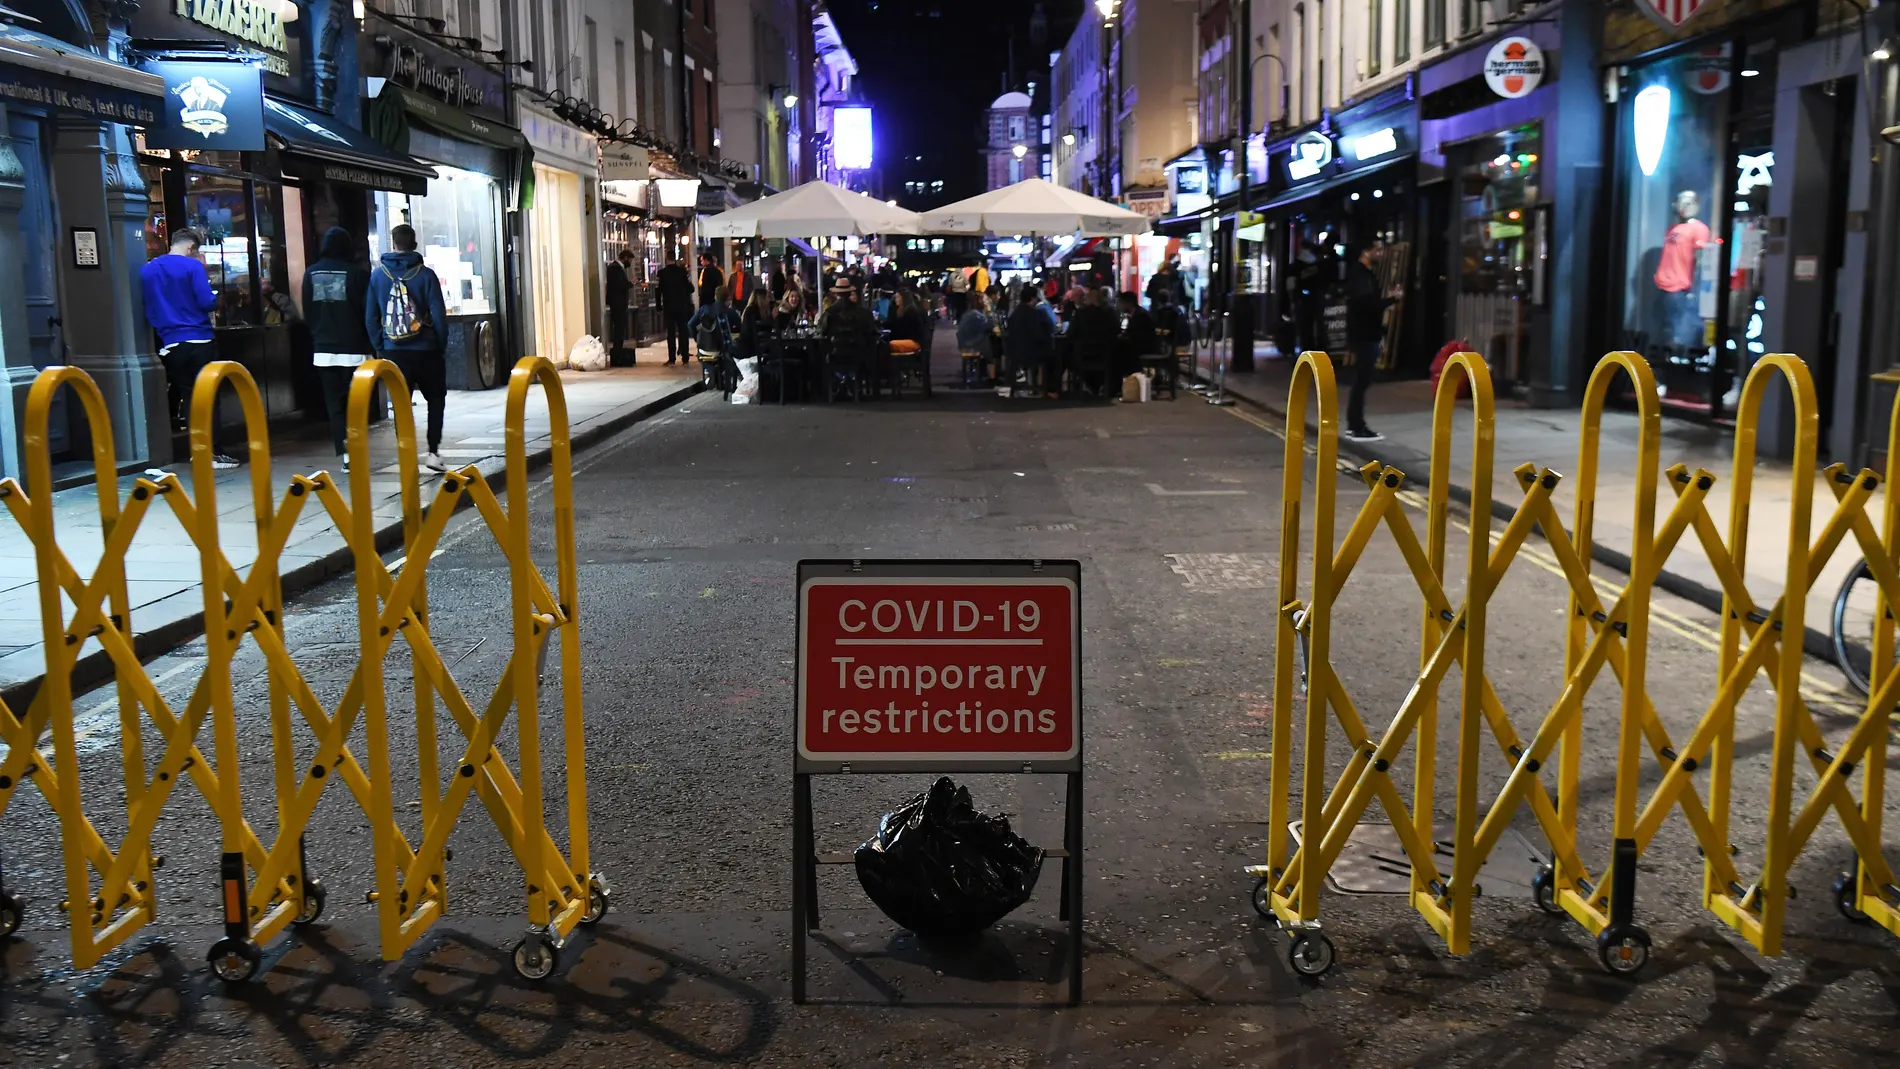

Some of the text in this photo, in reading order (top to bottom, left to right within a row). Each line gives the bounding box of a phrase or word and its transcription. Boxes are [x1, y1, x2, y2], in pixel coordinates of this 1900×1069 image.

[413, 48, 455, 105] Vintage
[457, 67, 484, 110] House
[54, 89, 71, 108] UK
[71, 95, 96, 115] calls,
[96, 98, 115, 116] text
[122, 103, 136, 120] 4G
[838, 600, 1041, 632] COVID-19
[831, 656, 1047, 695] Temporary
[821, 701, 1056, 733] restrictions
